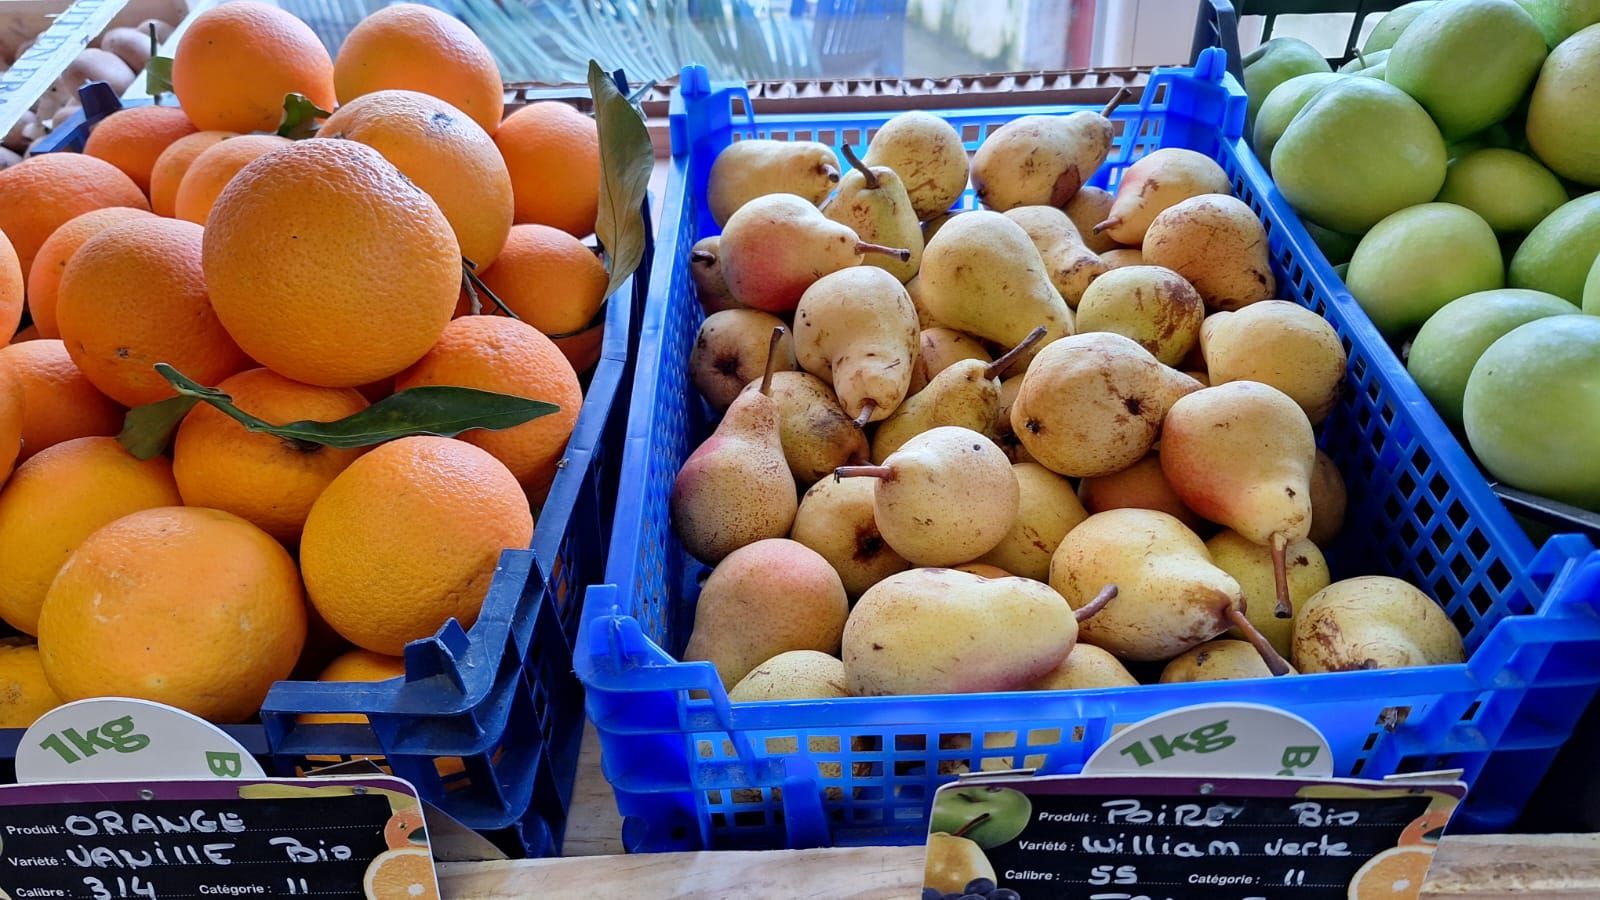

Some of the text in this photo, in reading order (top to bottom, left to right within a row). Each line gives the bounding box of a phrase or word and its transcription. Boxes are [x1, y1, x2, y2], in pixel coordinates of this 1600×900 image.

[39, 715, 151, 764] 1kg
[1120, 719, 1236, 767] 1kg
[65, 809, 246, 836] ORANGE
[1289, 801, 1360, 827] Bio
[269, 836, 352, 863] Bio
